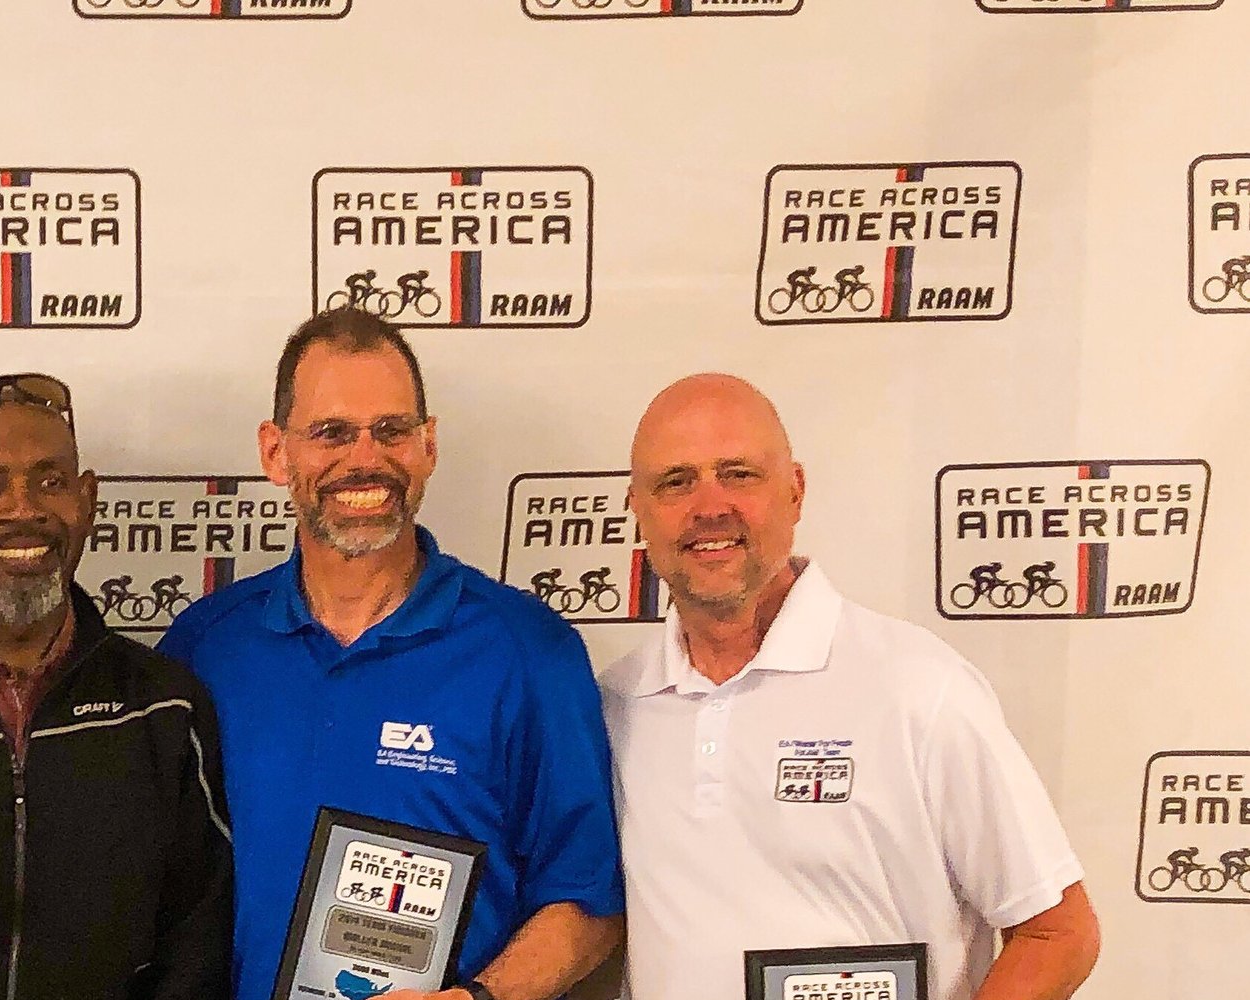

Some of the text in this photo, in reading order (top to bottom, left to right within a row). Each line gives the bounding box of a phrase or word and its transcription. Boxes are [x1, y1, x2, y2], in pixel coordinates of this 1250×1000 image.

[785, 187, 1000, 208] RACE ACROSS
[1211, 179, 1250, 196] RA
[334, 191, 571, 210] RACE ACROSS
[334, 215, 570, 245] AMERICA
[783, 210, 998, 243] AMERICA
[41, 295, 122, 317] RAAM
[491, 294, 572, 316] RAAM
[917, 287, 994, 310] RAAM
[527, 496, 608, 514] RACE
[957, 484, 1191, 506] RACE ACROSS
[94, 496, 297, 520] RACE ACROS
[957, 508, 1188, 539] AMERICA
[87, 522, 286, 552] AMERIC
[1114, 582, 1180, 606] RAAM
[380, 721, 434, 751] EA
[783, 771, 848, 780] AMERICA
[1162, 775, 1244, 791] RACE
[353, 850, 445, 877] RACE ACROSS
[350, 860, 443, 890] AMERICA
[403, 903, 436, 917] RAAM
[792, 980, 891, 992] RACE ACROSS
